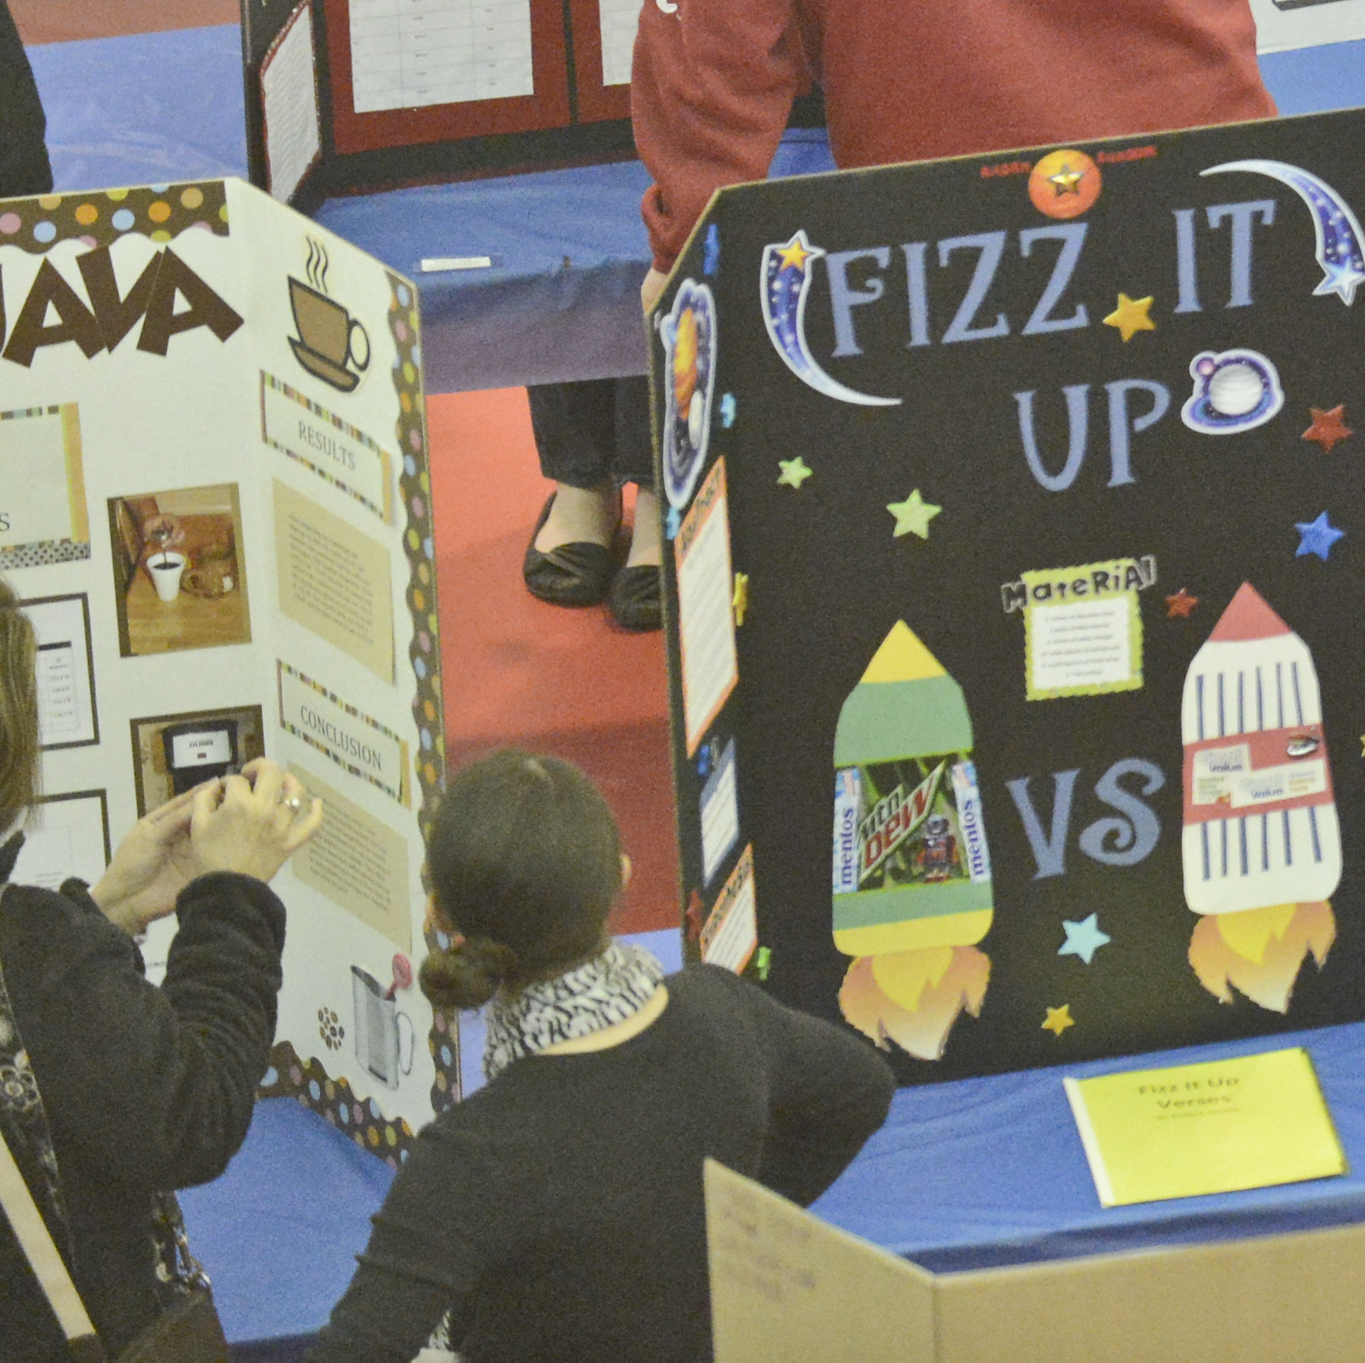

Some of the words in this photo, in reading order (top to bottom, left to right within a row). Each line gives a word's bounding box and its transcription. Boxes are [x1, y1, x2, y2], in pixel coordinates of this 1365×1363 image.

[0, 243, 244, 368] AVA
[824, 221, 1087, 359] FIZZ
[1172, 199, 1276, 315] IT
[297, 419, 356, 472] RESULTS
[1013, 378, 1169, 493] UP
[300, 703, 383, 772] CONCLUSION
[841, 807, 855, 886] mentos
[963, 799, 985, 876] mentos
[1005, 757, 1165, 880] VS
